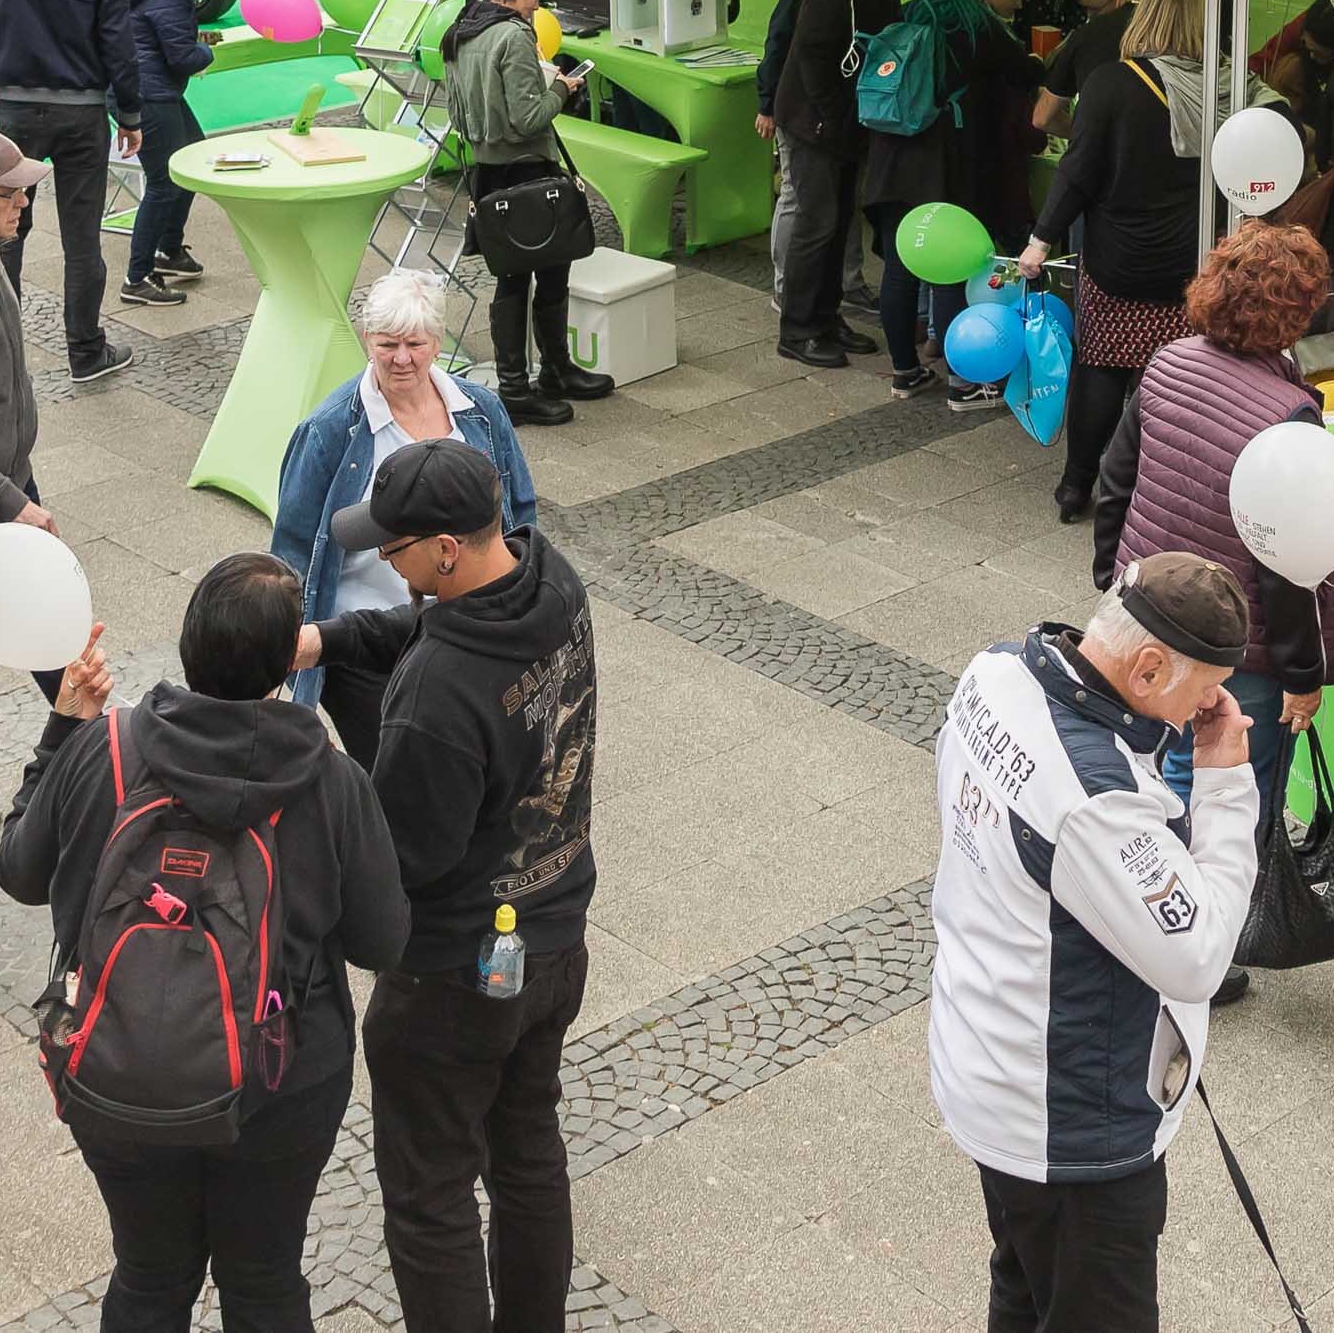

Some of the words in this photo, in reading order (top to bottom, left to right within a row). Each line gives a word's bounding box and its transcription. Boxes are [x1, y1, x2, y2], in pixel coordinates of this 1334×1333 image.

[1226, 185, 1258, 202] radio
[994, 764, 1024, 802] TYPE
[1159, 889, 1192, 928] 63
